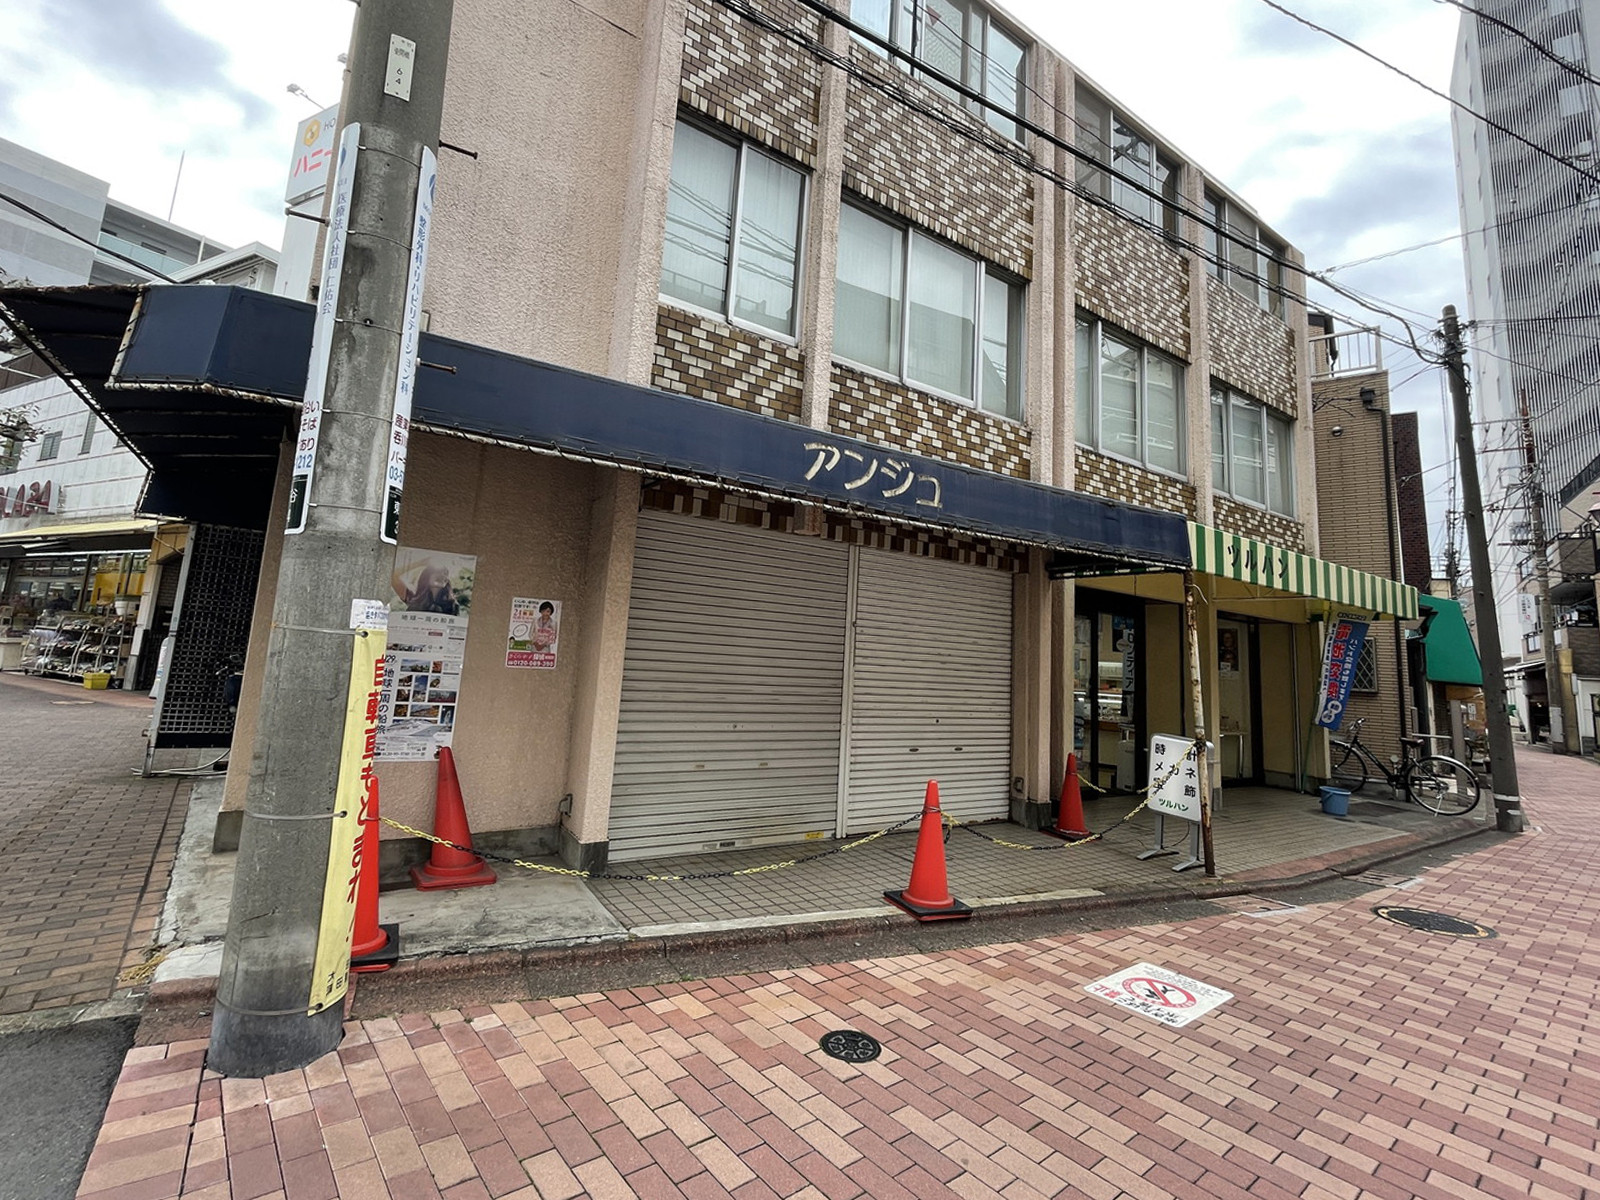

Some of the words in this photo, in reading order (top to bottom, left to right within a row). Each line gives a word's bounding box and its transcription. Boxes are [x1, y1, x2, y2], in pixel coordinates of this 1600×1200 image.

[299, 438, 315, 451] あり
[1227, 545, 1288, 579] ツルハン
[1159, 798, 1189, 812] ツルハン
